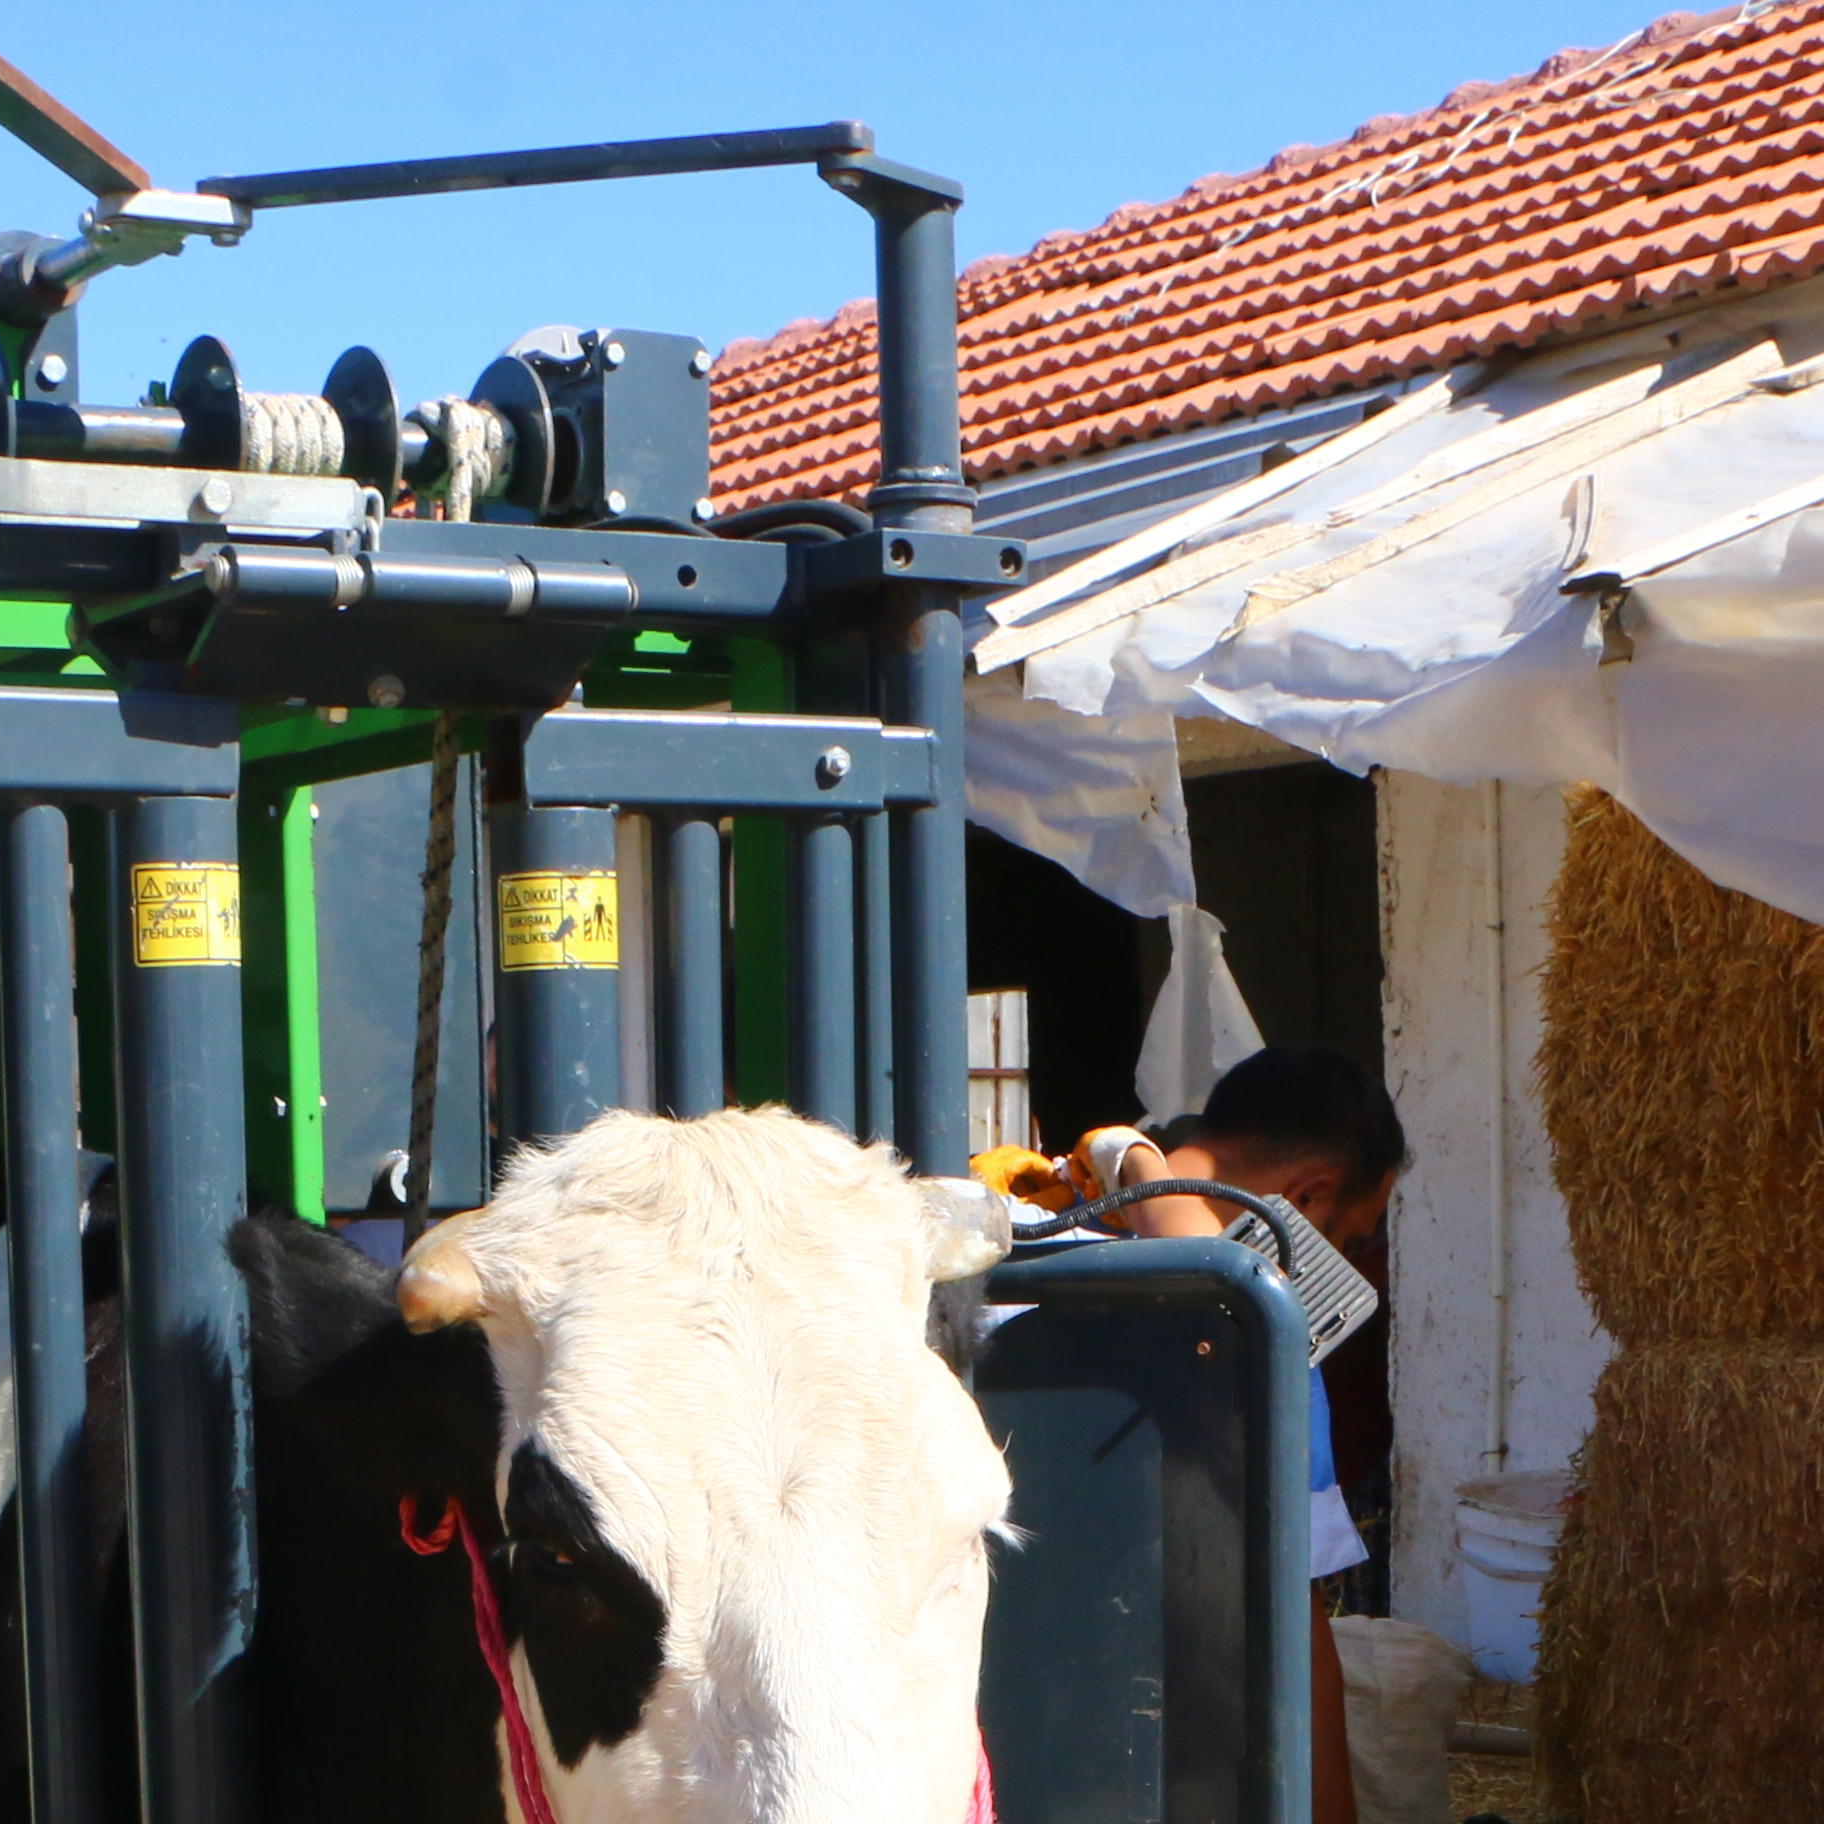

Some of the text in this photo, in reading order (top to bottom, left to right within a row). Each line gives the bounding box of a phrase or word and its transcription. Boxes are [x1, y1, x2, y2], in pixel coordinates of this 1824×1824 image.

[166, 878, 202, 896] DİKKAT
[523, 886, 559, 902] DİKKAT
[505, 927, 556, 945] TEHLİKES
